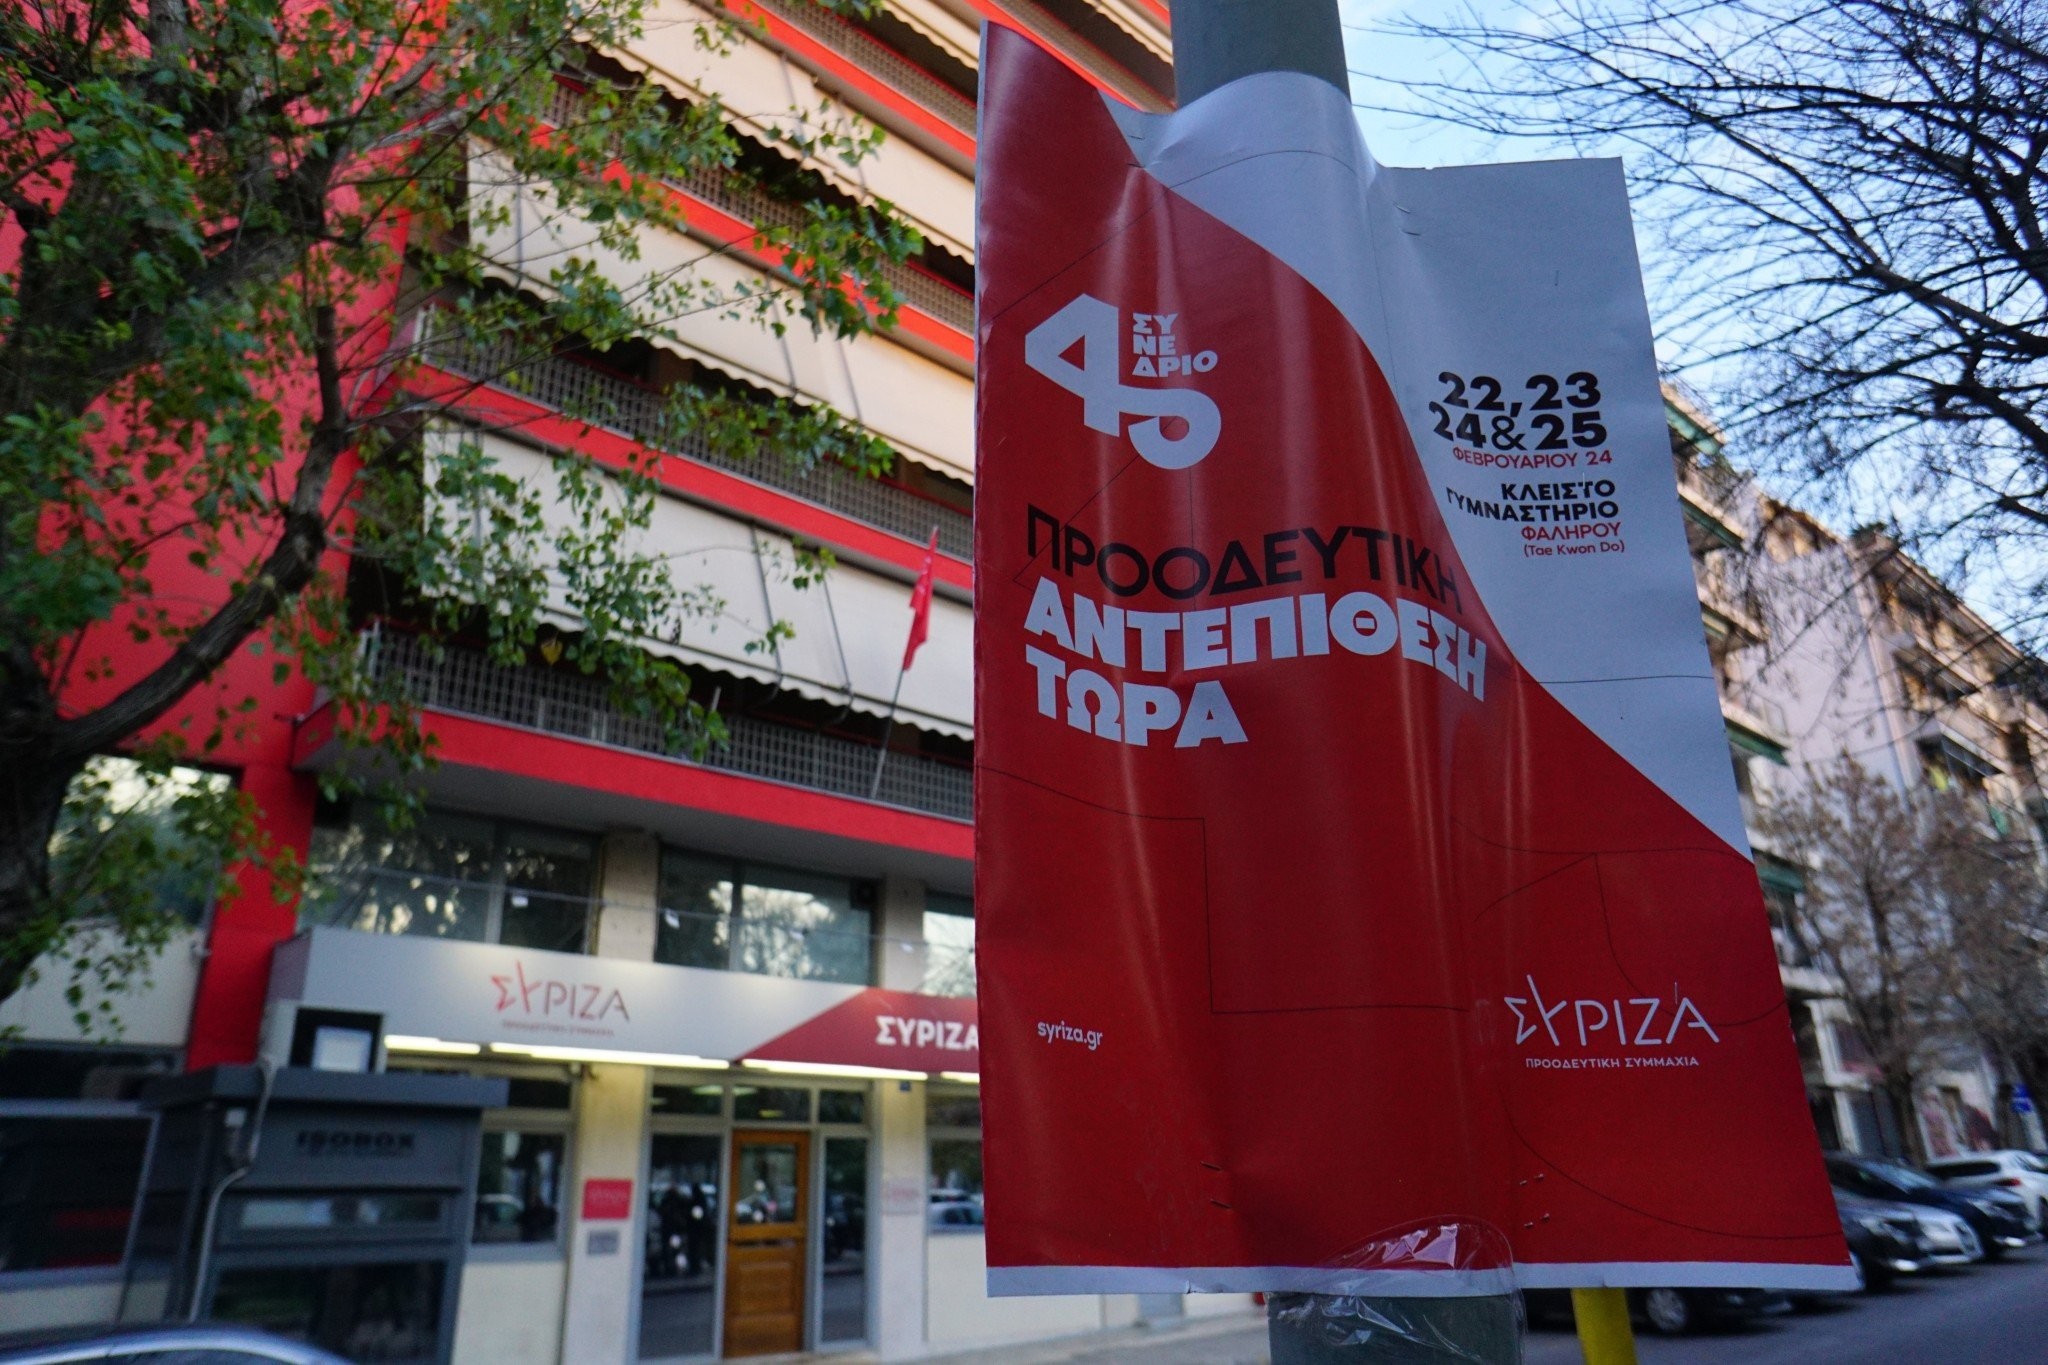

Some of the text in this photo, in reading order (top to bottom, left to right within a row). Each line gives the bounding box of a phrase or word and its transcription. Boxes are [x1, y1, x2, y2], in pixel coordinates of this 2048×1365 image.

[1132, 313, 1178, 334] ΣΥ
[1132, 334, 1176, 356] ΝΕ
[1131, 350, 1218, 378] ΔΡΙΟ
[1452, 446, 1612, 469] ΦΕΒΡΟΥΑΡΙΟΥ 24
[1501, 479, 1616, 501] ΚΛΕΙΣΤΟ
[1446, 486, 1619, 522] ΓΥΜΝΑΣΤΗΡΙΟ
[1521, 521, 1621, 541] ΦΑΛΗΡΟΥ
[1027, 503, 1463, 616] ΠΡΟΟΔΕΥΤΙΚΗ
[1524, 539, 1625, 558] (Tae Kwon Do)
[1023, 576, 1487, 702] ΑΝΤΕΠΙΘΕΣΗ
[1025, 644, 1249, 748] ΤΩΡΑ
[1037, 1020, 1103, 1051] syriza.gr
[1525, 1056, 1699, 1069] ΠΡΟΟΔΕΥΤΙΚΗ ΣΥΜΜΑΧΙΑ
